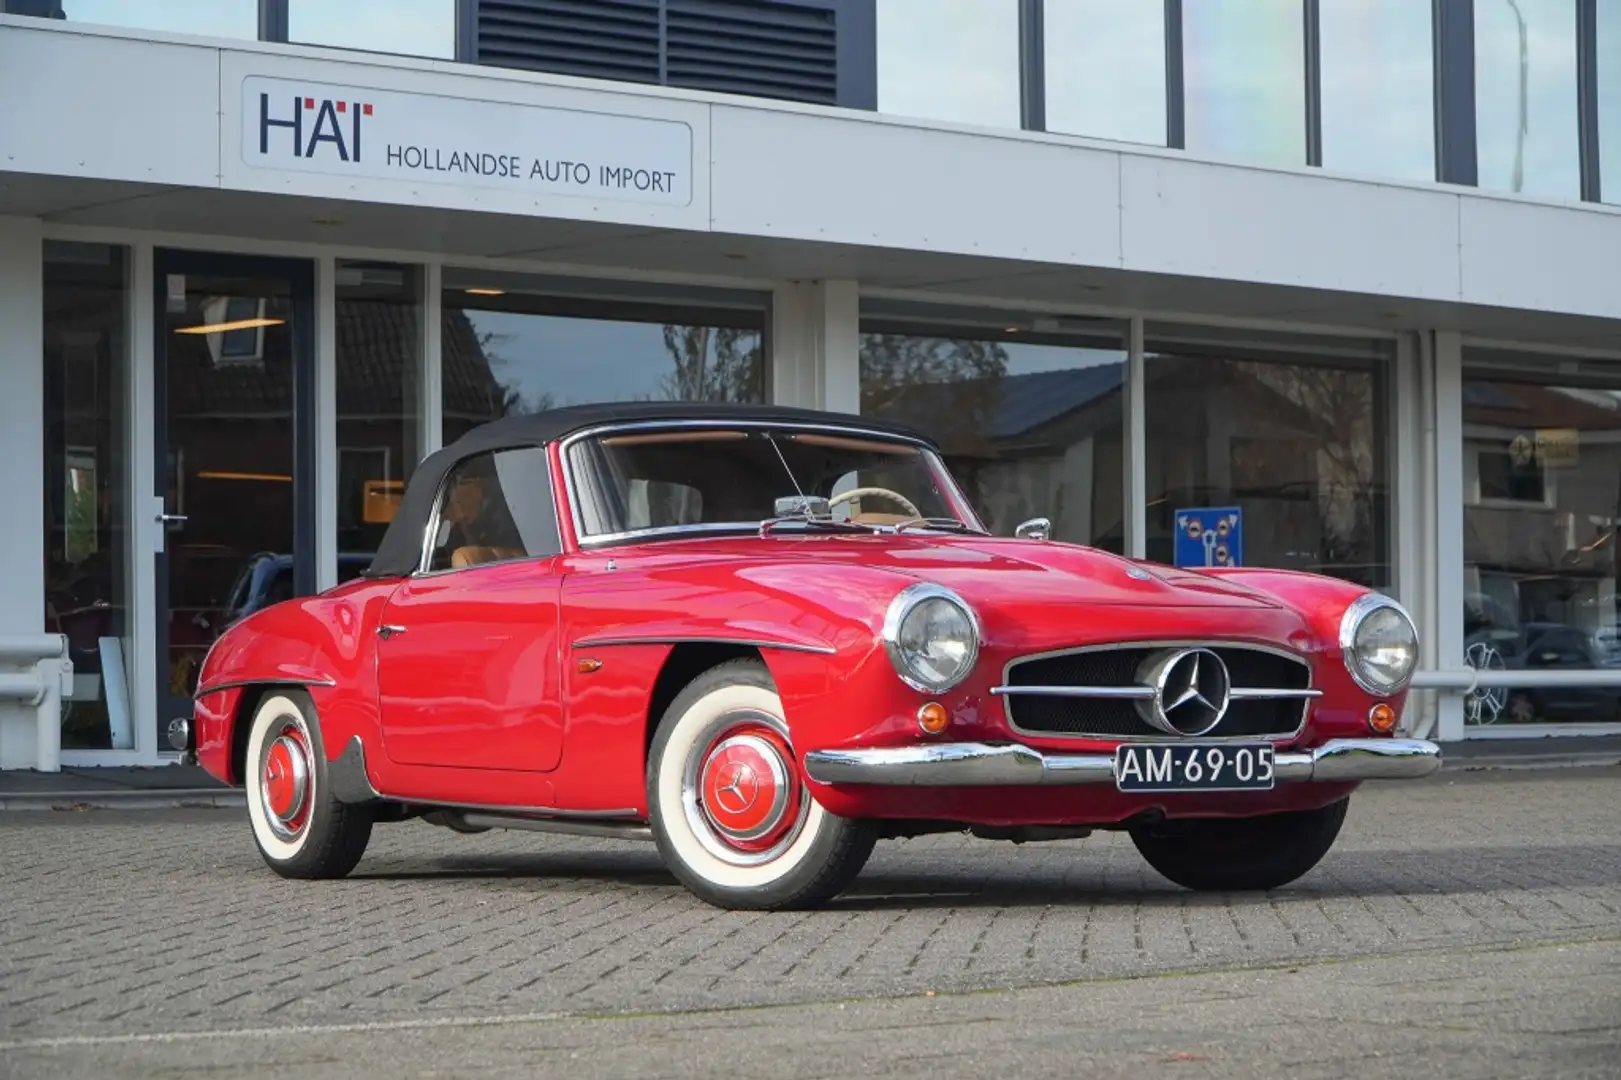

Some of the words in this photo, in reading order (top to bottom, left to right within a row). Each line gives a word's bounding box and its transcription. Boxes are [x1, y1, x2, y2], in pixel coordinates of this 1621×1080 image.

[387, 144, 520, 178] HOLLANDSE
[530, 159, 590, 185] AUTO
[600, 166, 676, 193] IMPORT
[1120, 748, 1273, 782] AM-69-05
